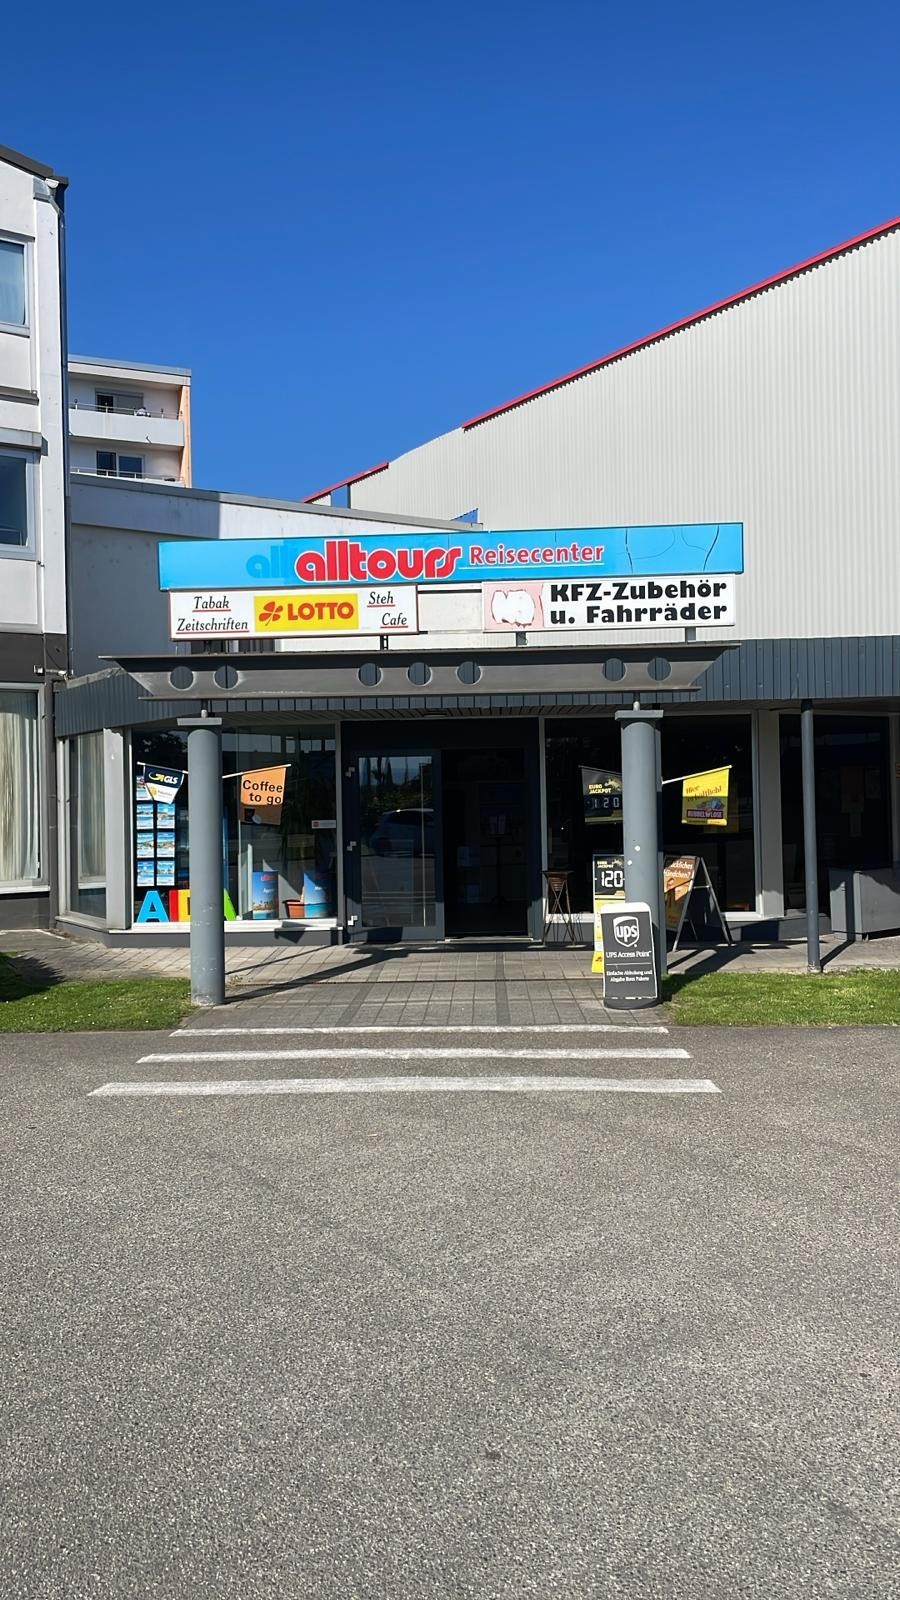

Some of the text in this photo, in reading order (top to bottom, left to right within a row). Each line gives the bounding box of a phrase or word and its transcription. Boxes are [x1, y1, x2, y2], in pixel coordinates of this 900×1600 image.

[295, 539, 605, 582] alltours Reisecenter
[368, 591, 394, 605] Steh
[550, 579, 727, 602] KFZ-Zubehör
[194, 595, 231, 609] Tabak
[287, 601, 354, 621] LOTTO
[550, 602, 727, 625] u. Fahrräder
[177, 618, 249, 632] Zeitschriften
[381, 612, 408, 627] Cafe
[163, 775, 178, 785] GLS
[242, 780, 283, 793] Coffee
[249, 793, 282, 805] to go
[601, 870, 624, 888] 120
[615, 925, 638, 943] ups
